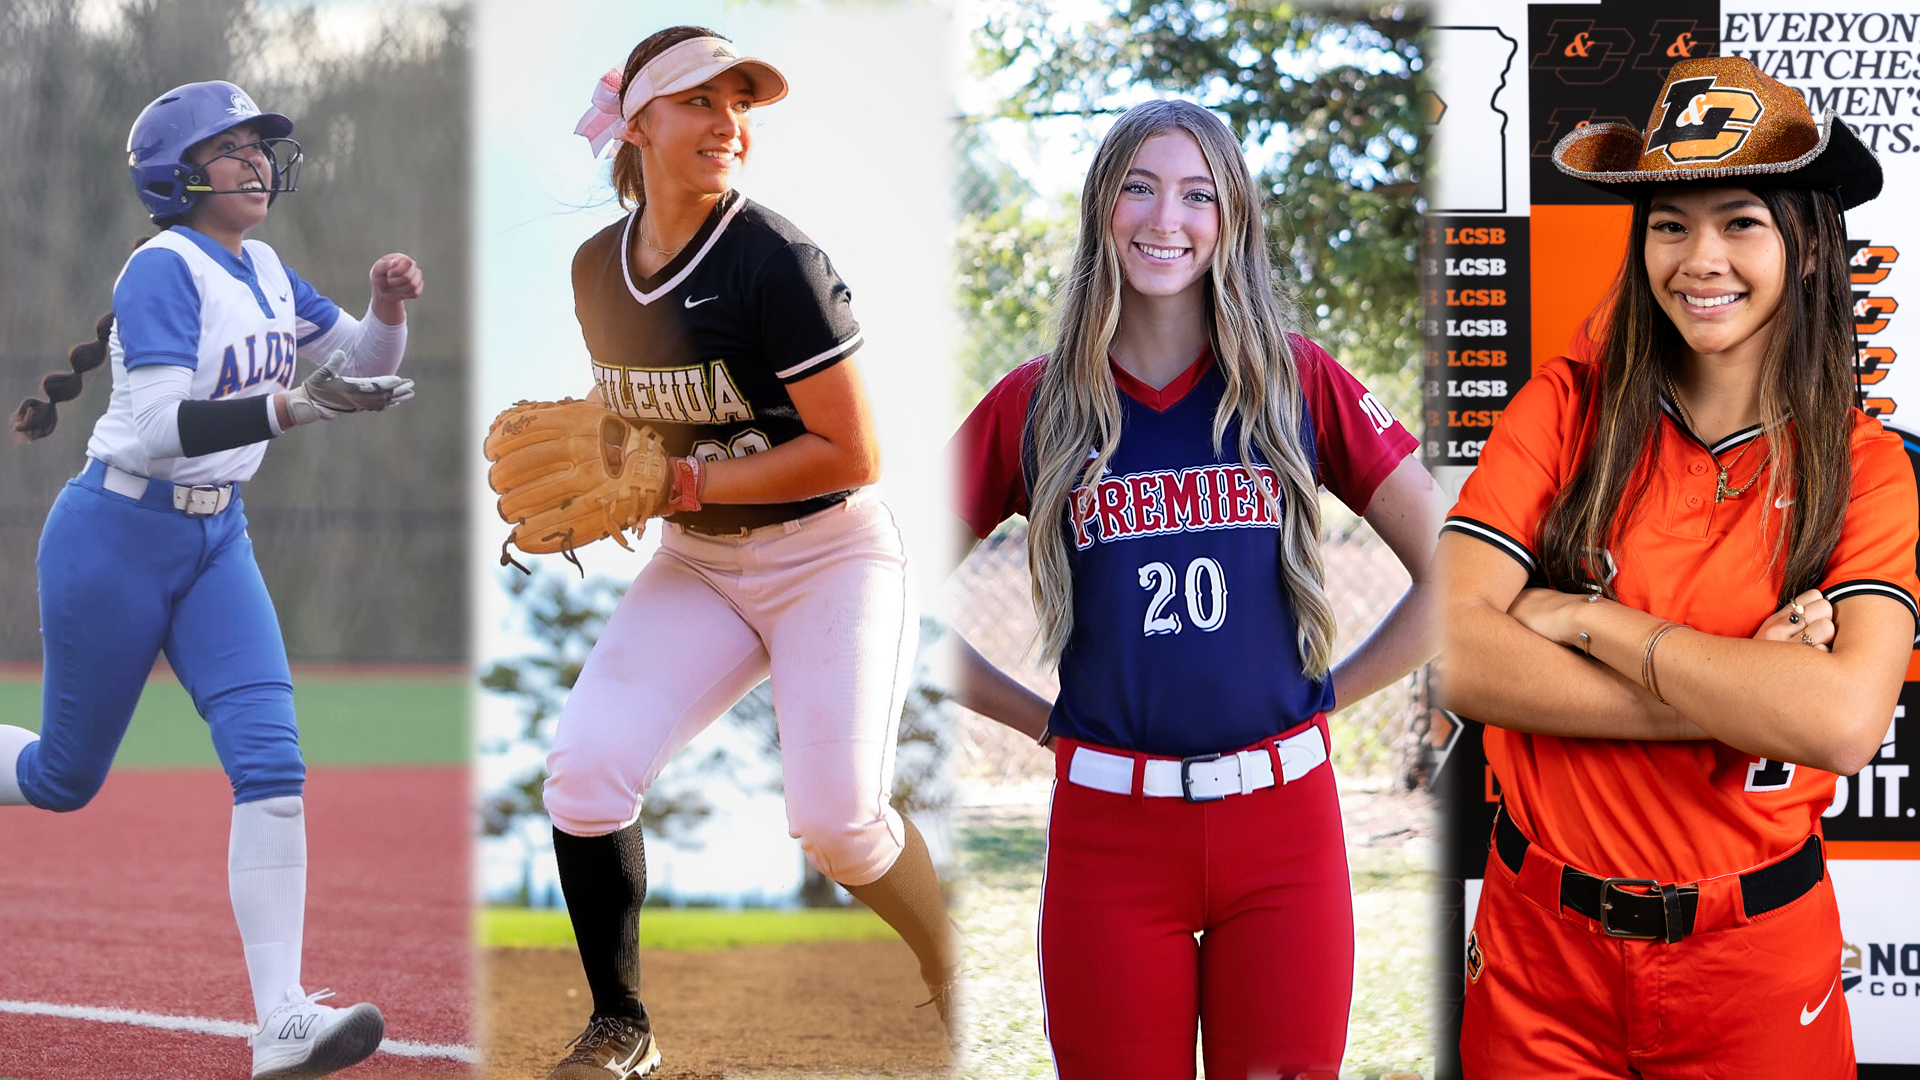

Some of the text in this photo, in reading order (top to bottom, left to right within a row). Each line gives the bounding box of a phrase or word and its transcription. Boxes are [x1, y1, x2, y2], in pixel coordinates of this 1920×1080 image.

[1445, 228, 1506, 245] LCSB
[1445, 258, 1507, 276] LCSB
[1446, 289, 1507, 306] LCSB
[1446, 319, 1508, 337] LCSB
[1447, 350, 1508, 367] LCSB
[592, 360, 755, 424] ILEHUA
[1447, 380, 1508, 397] LCSB
[1066, 463, 1284, 551] PREMIER
[1137, 556, 1229, 638] 20
